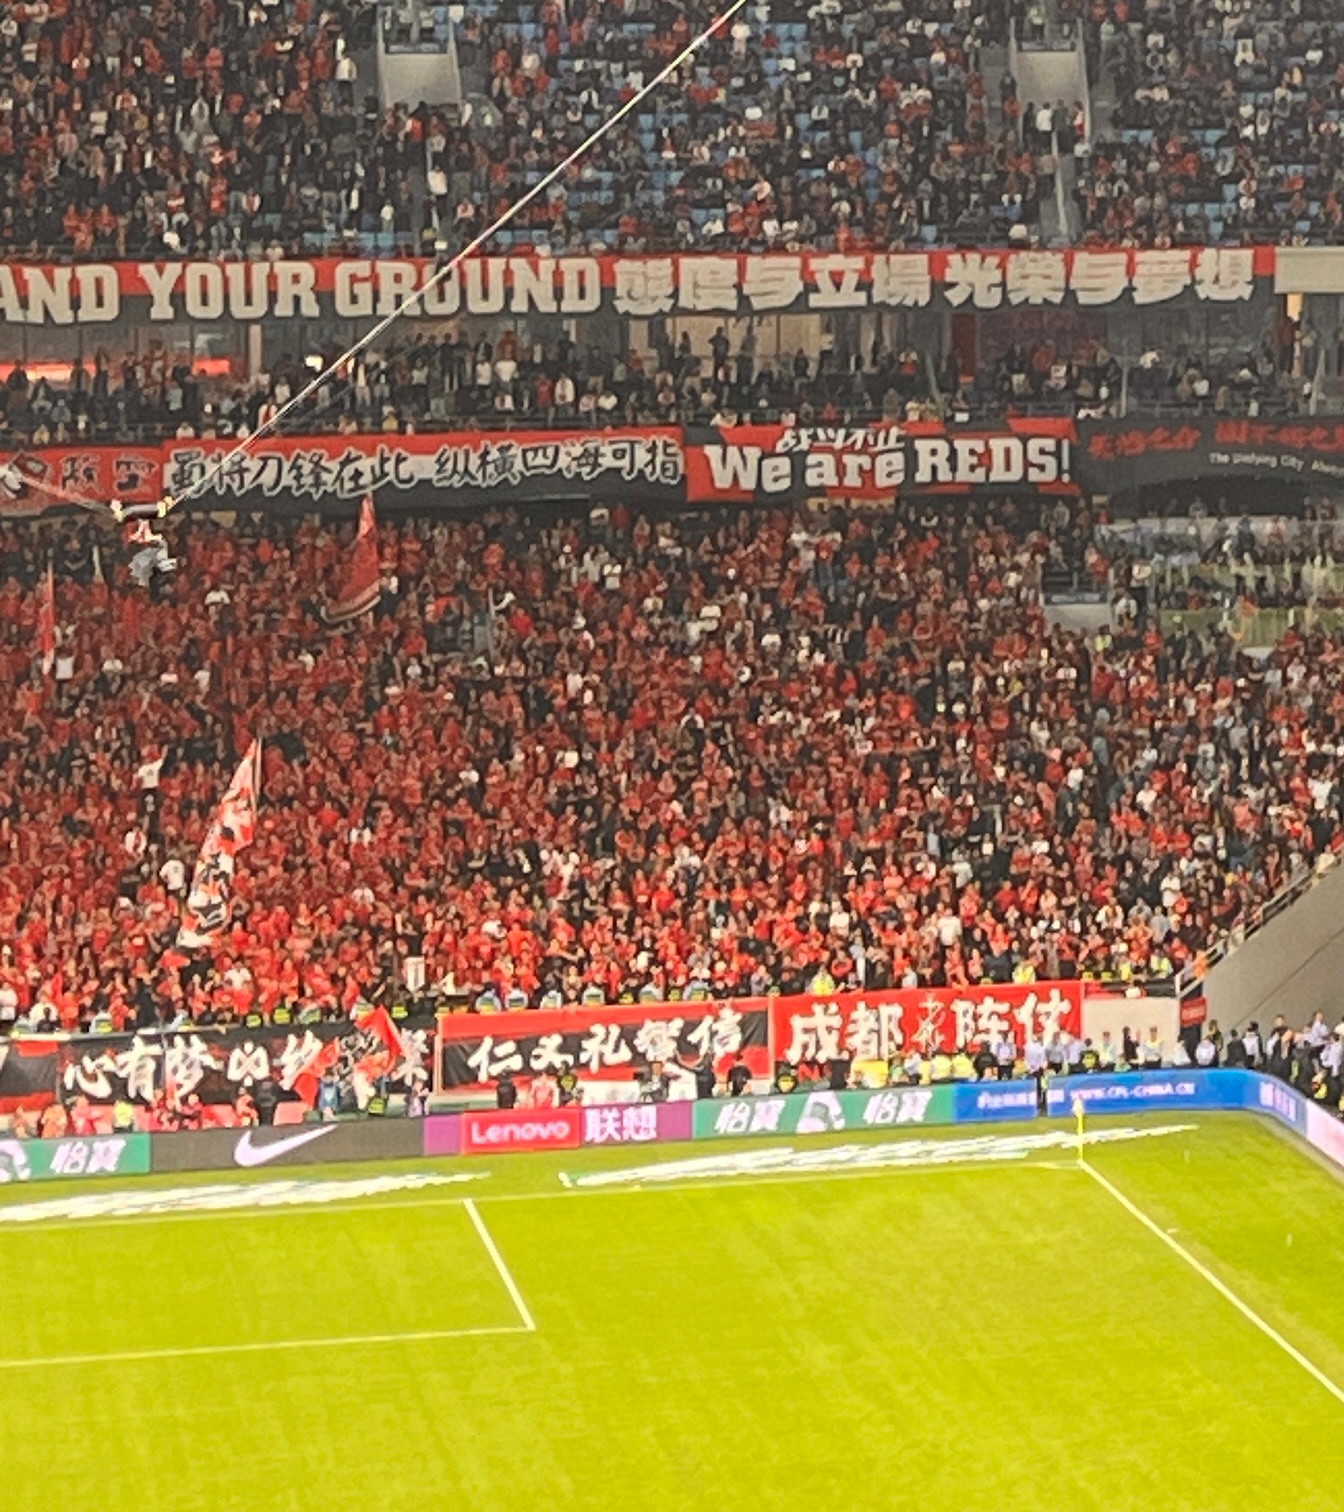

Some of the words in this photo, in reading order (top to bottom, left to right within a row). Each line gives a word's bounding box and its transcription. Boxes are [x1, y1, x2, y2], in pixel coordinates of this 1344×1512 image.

[0, 262, 120, 325] AND
[138, 261, 320, 320] YOUR
[334, 256, 601, 318] GROUND
[703, 444, 791, 493] We
[805, 450, 905, 488] are
[914, 439, 1071, 483] REDS!
[471, 1120, 570, 1145] Lenovo
[584, 1105, 658, 1144] 联想
